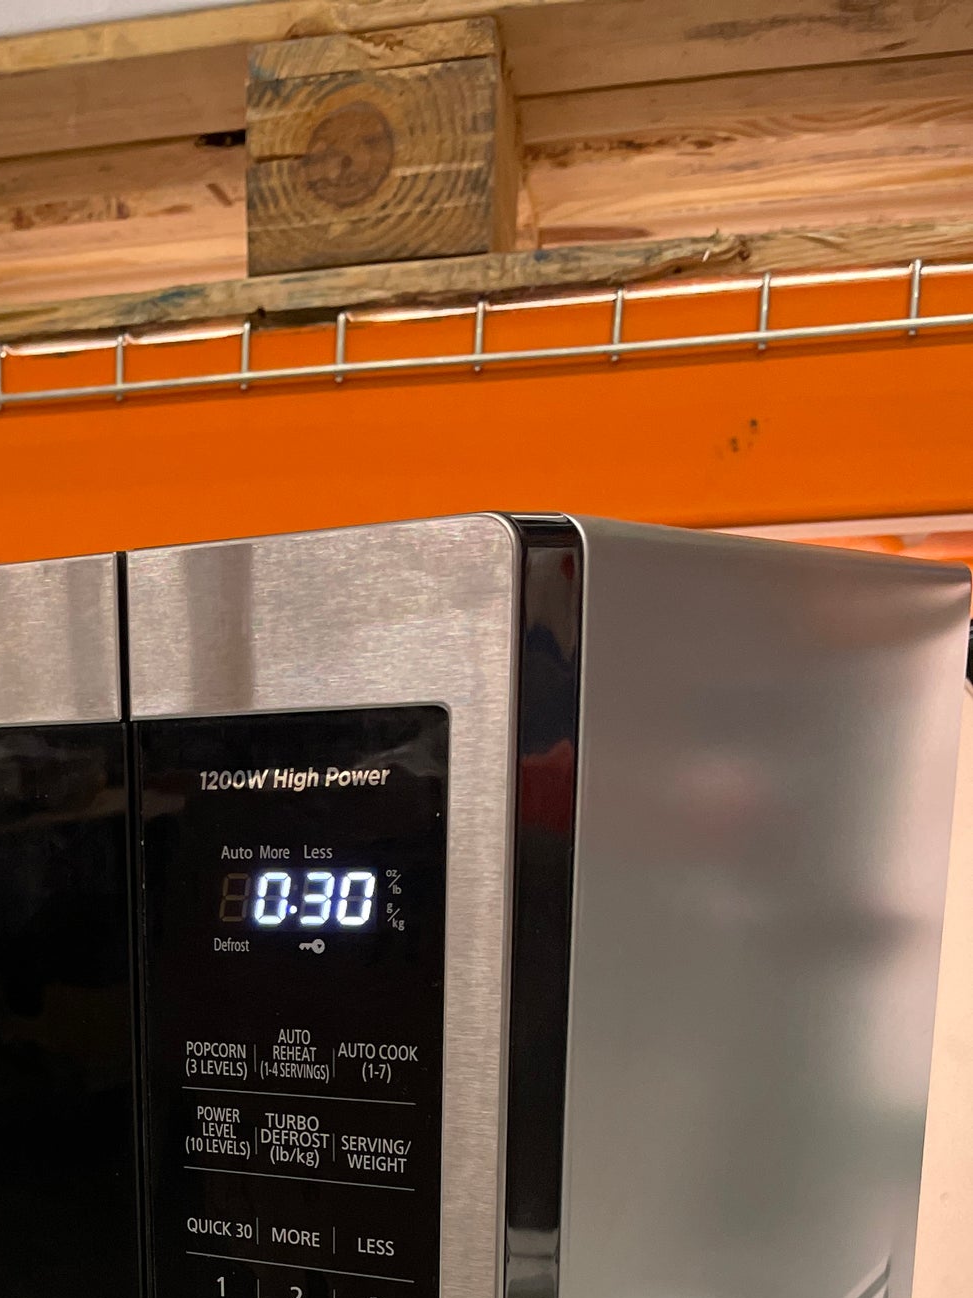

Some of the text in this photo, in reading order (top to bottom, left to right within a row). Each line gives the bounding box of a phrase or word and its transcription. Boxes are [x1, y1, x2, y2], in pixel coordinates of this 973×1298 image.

[200, 766, 391, 792] 1200W High Power
[221, 845, 333, 860] Auto More Less
[213, 937, 250, 952] Defrost
[277, 1028, 311, 1045] AUTO
[186, 1041, 247, 1059] POPCORN
[272, 1045, 317, 1062] REHEAT
[337, 1042, 419, 1062] AUTO COOK
[185, 1058, 248, 1081] (3 LEVELS)
[279, 1062, 330, 1084] SERVINGS)
[362, 1062, 392, 1084] (1-7)
[196, 1106, 241, 1124] POWER
[265, 1112, 319, 1132] TURBO
[202, 1122, 237, 1139] LEVEL
[260, 1128, 330, 1149] DEFROST
[185, 1136, 251, 1160] (10 LEVELS)
[340, 1135, 412, 1155] SERVING/
[269, 1147, 320, 1168] (lb/kg)
[347, 1154, 408, 1174] WEIGHT
[186, 1217, 253, 1239] QUICK 30
[271, 1227, 321, 1248] MORE
[357, 1237, 395, 1257] LESS
[216, 1276, 225, 1297] 1
